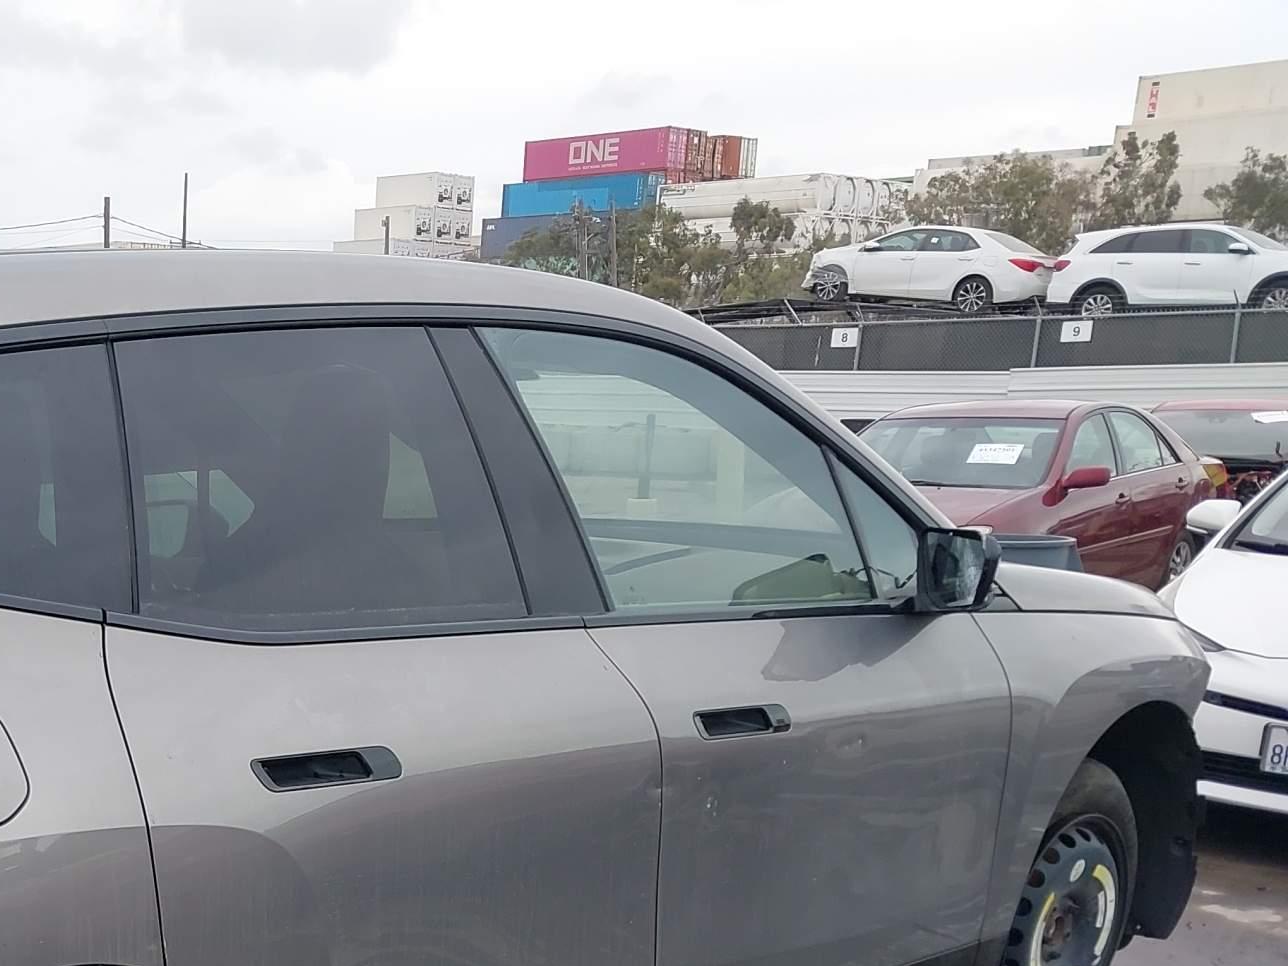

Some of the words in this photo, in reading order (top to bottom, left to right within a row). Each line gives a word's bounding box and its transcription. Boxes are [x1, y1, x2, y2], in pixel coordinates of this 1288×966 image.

[568, 137, 620, 165] ONE
[1072, 326, 1081, 337] 9
[841, 332, 848, 343] 8
